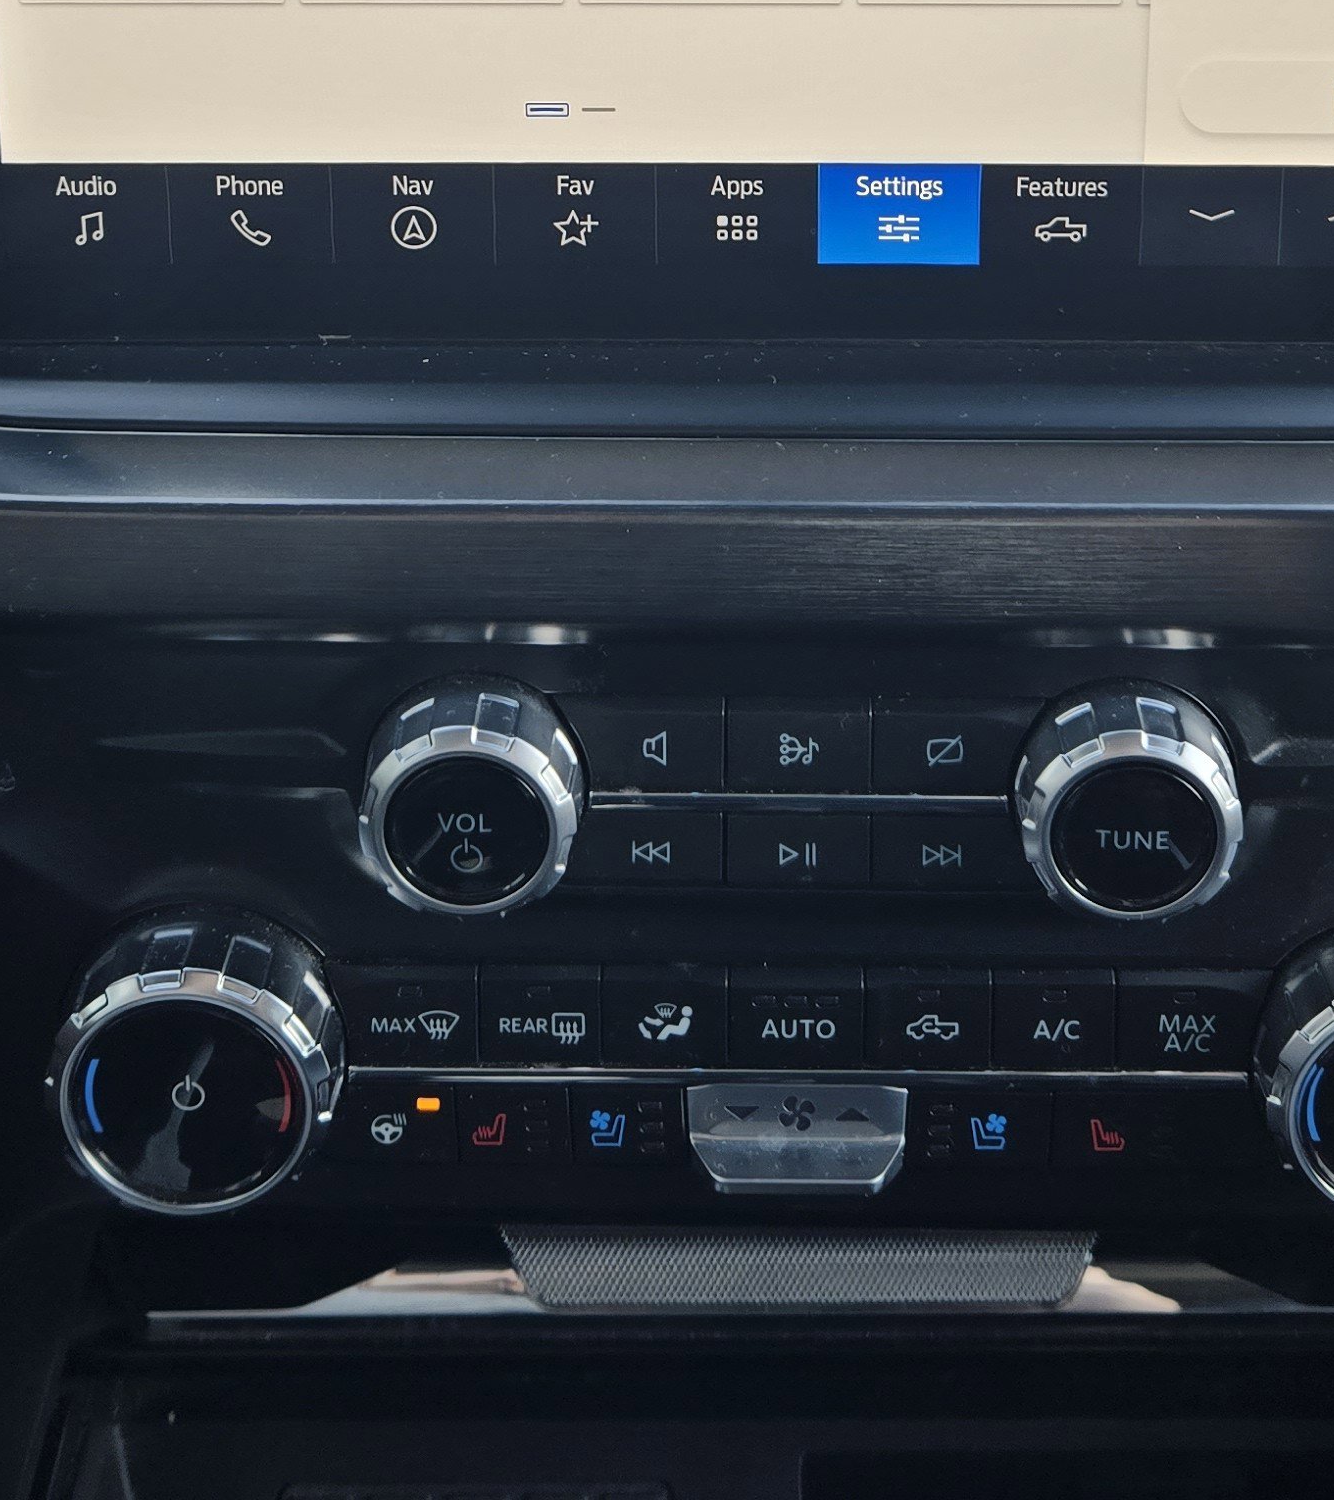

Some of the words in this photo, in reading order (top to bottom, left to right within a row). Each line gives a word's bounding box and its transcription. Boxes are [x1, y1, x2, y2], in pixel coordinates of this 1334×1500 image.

[55, 175, 117, 196] Audio
[216, 174, 284, 196] Phone
[392, 175, 434, 196] Nav
[557, 175, 595, 196] Fav
[710, 175, 764, 200] Apps
[855, 175, 944, 201] Settings
[1016, 176, 1108, 197] Features
[437, 813, 492, 833] VOL
[1095, 829, 1170, 850] TUNE
[371, 1017, 416, 1033] MAX
[499, 1017, 548, 1034] REAR
[761, 1018, 836, 1039] AUTO
[1033, 1018, 1080, 1042] A/C
[1158, 1014, 1216, 1033] MAX
[1163, 1029, 1211, 1053] A/C
